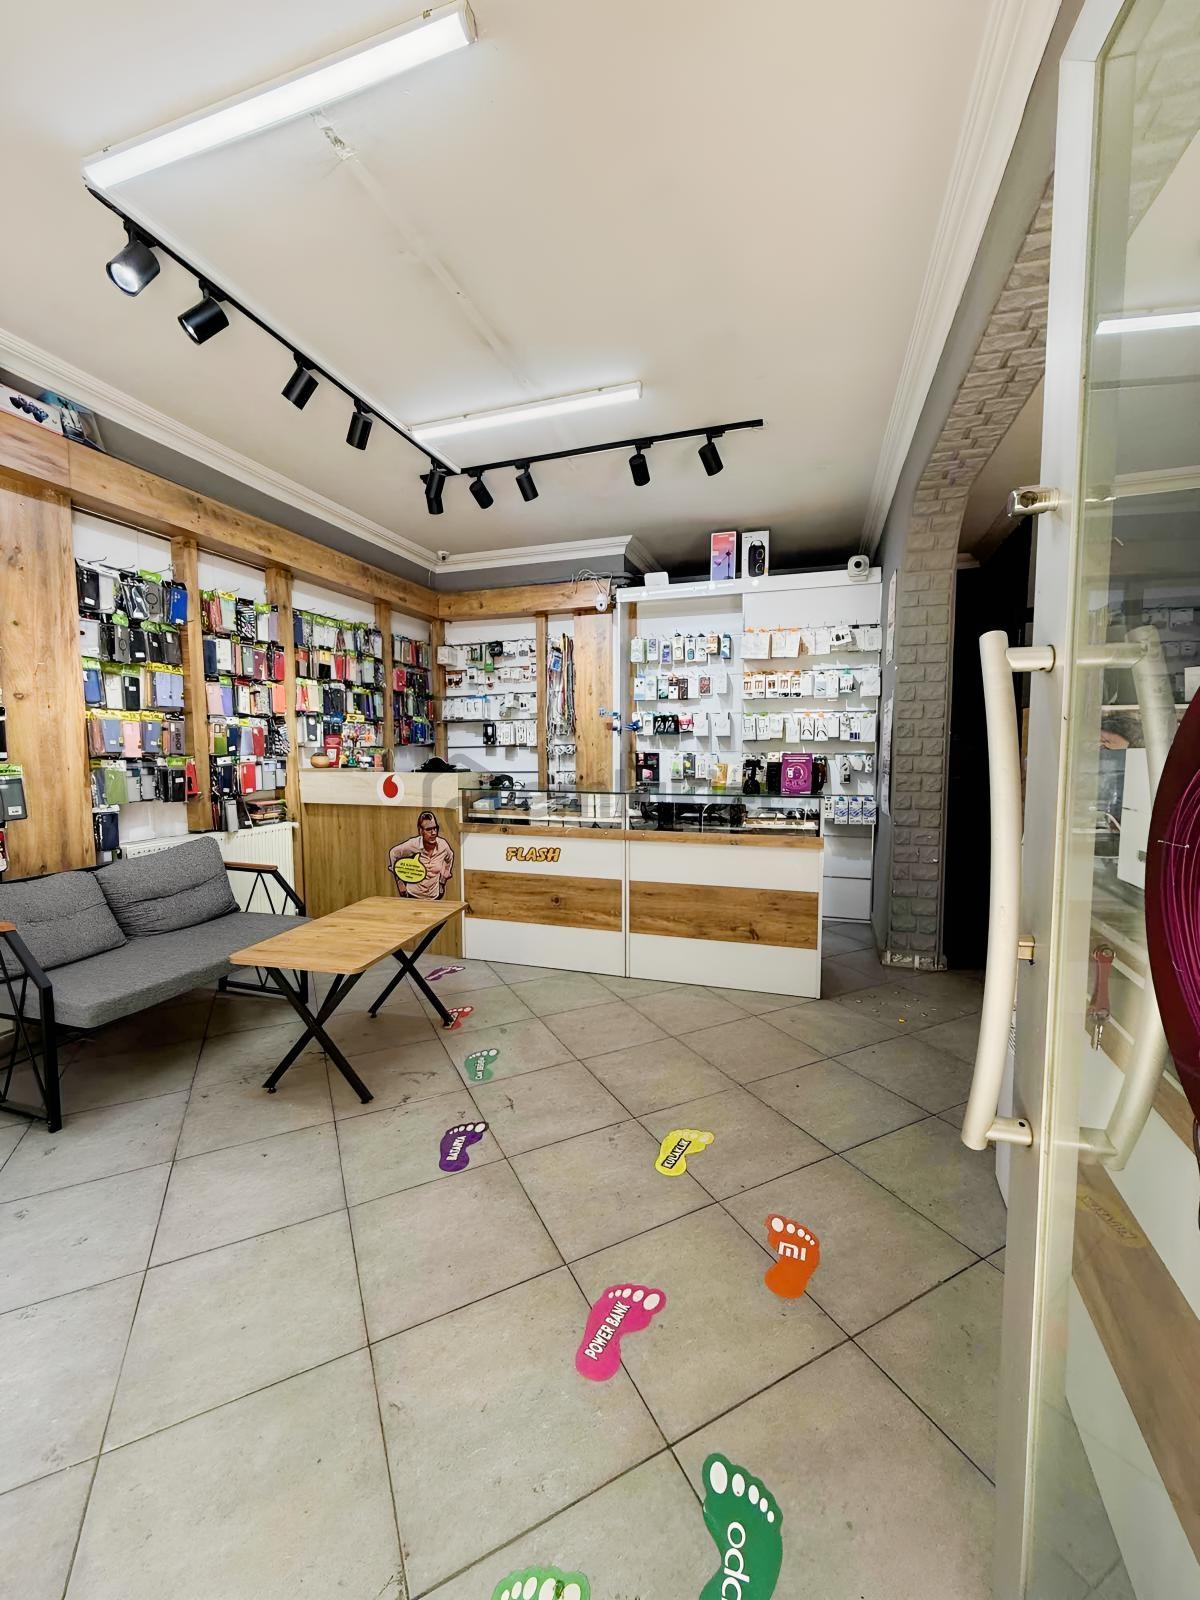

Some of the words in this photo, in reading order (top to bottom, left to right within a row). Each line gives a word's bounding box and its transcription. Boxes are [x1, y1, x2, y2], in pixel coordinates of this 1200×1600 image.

[505, 847, 561, 863] FLASH
[584, 1326, 614, 1360] POWER
[608, 1300, 631, 1327] BANK
